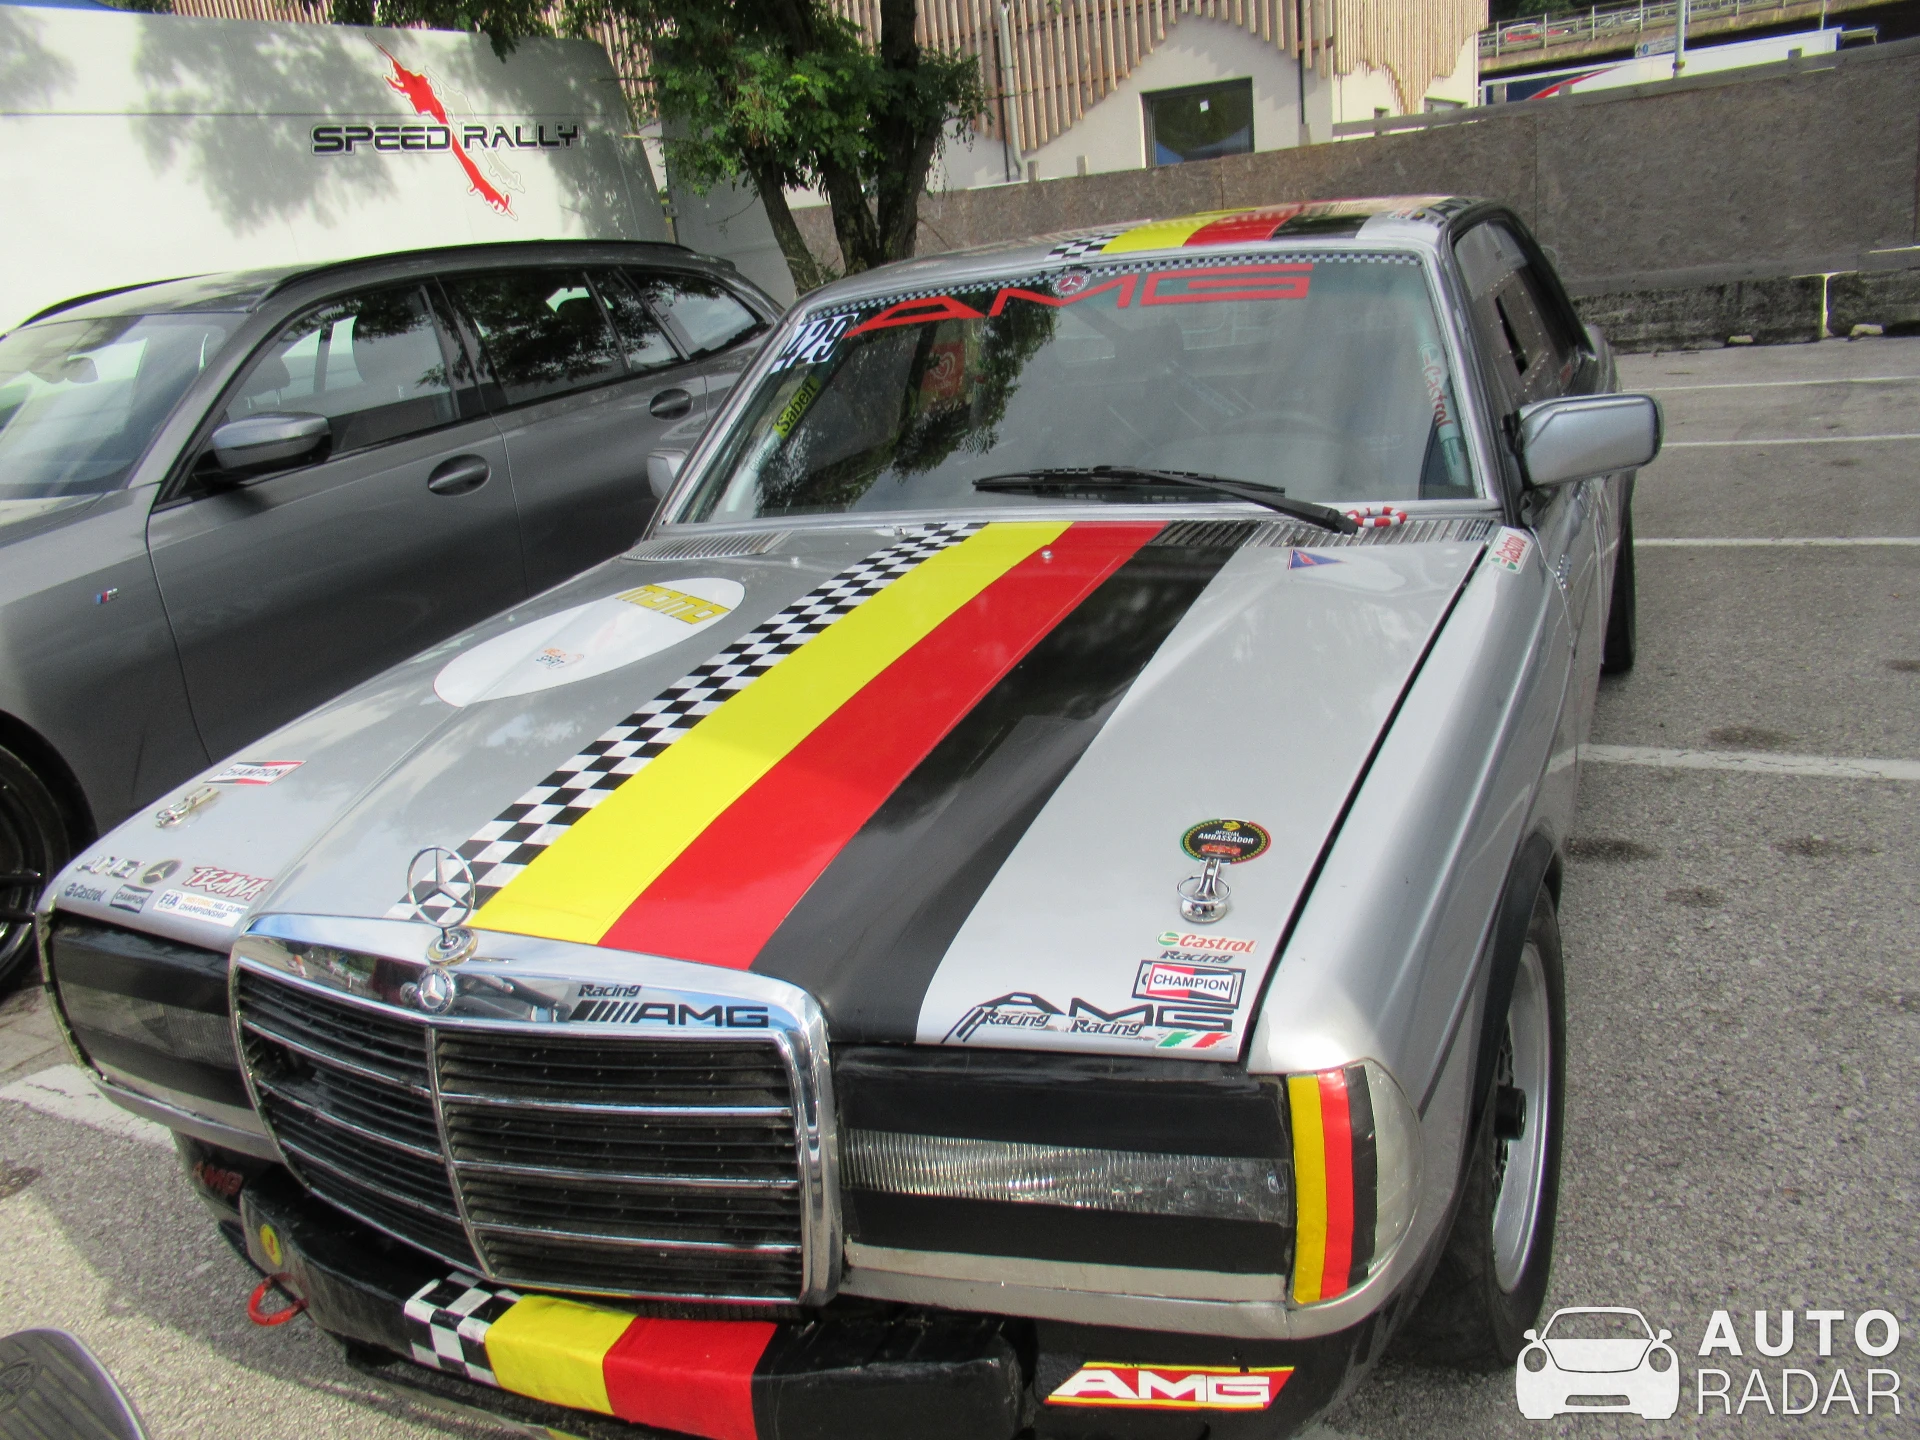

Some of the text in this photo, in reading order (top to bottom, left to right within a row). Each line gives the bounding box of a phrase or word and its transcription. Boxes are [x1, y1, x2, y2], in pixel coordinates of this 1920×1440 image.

[311, 124, 578, 152] SPEED RALLY
[844, 263, 1314, 338] AMG
[769, 314, 856, 372] 429
[1424, 366, 1454, 427] Castrol
[1495, 533, 1527, 563] Castrol
[219, 767, 288, 778] CHAMPION
[1198, 833, 1254, 845] AMBASSADOR
[1215, 829, 1240, 837] OFFICIAL
[73, 884, 107, 901] Castrol
[115, 891, 147, 906] CHAMPION
[160, 893, 180, 907] FIA
[178, 903, 228, 919] CHAMPIONSHIP
[213, 901, 227, 911] HILL
[1180, 934, 1257, 953] Castrol
[1159, 950, 1234, 963] Racing
[578, 984, 642, 997] Racing
[1153, 973, 1230, 992] CHAMPION
[981, 1006, 1051, 1028] Racing
[1070, 1018, 1146, 1036] Racing
[1050, 1369, 1270, 1404] AMG
